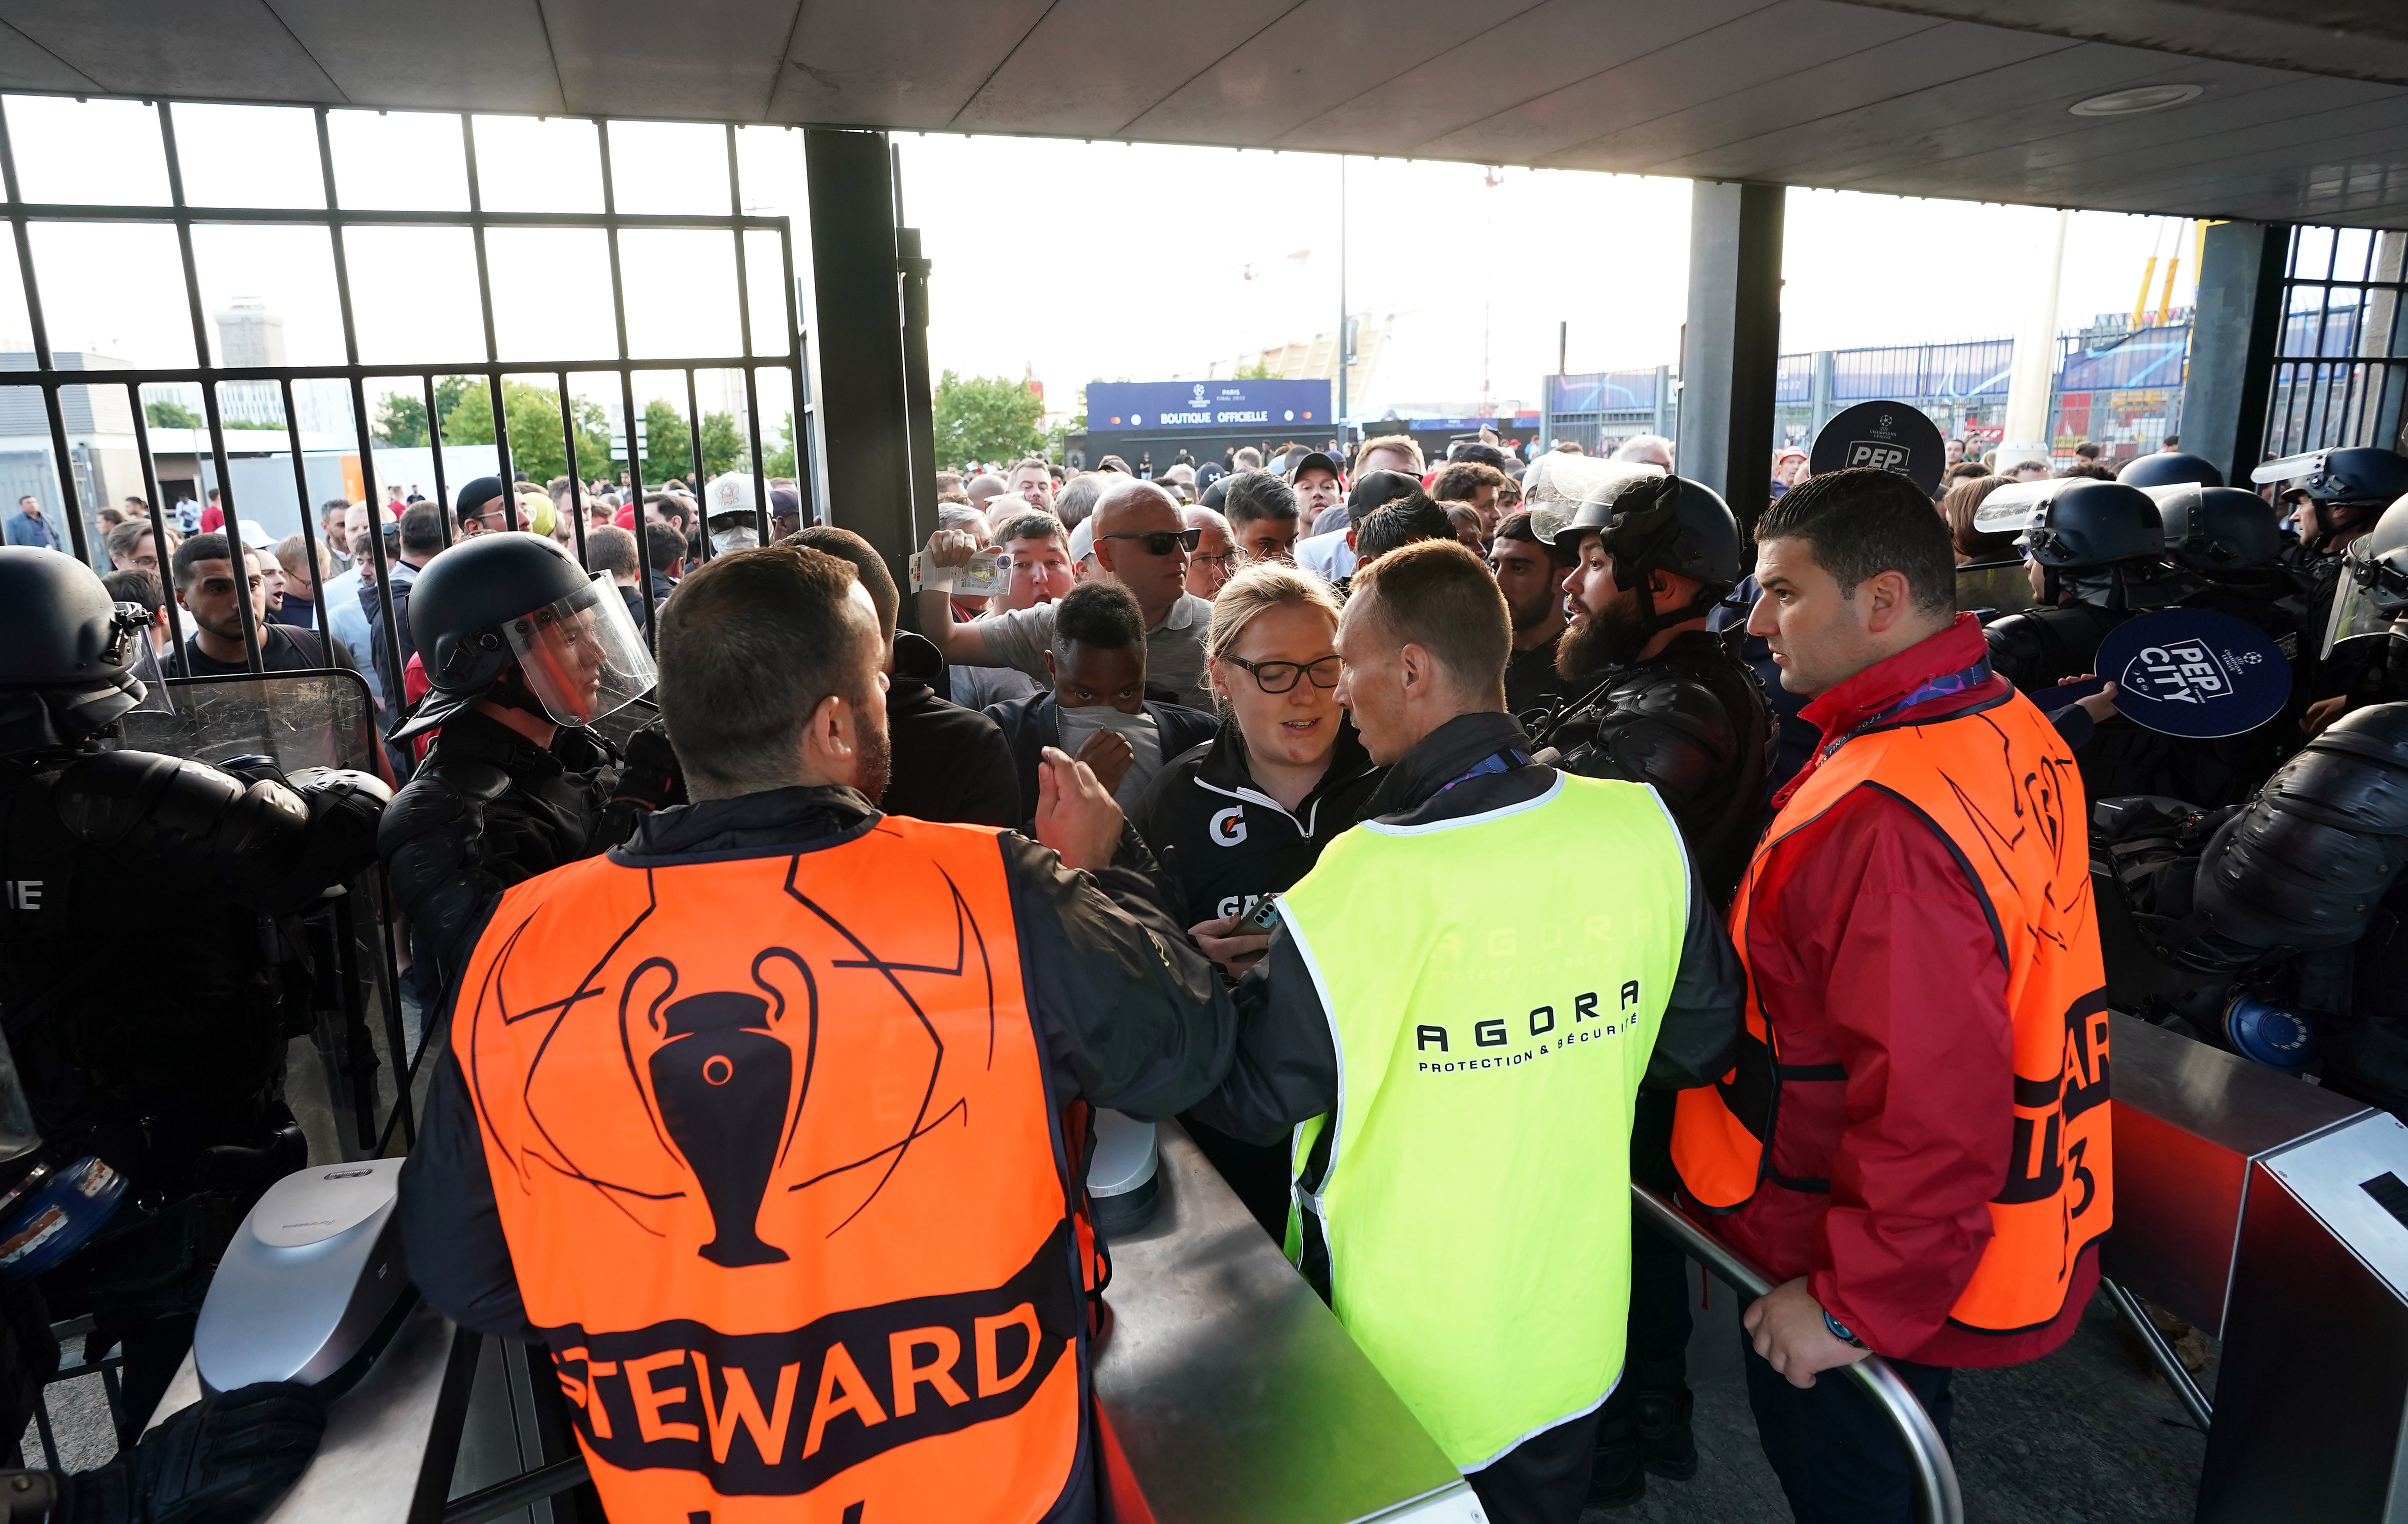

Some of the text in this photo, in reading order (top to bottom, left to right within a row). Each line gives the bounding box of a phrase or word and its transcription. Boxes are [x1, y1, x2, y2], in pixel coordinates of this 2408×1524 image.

[1160, 410, 1268, 425] BOUTIQUE OFFICIELLE
[1852, 446, 1902, 469] PEP
[718, 497, 741, 506] VERSACE
[2139, 647, 2198, 704] CITY
[2170, 647, 2222, 690] PEP
[2221, 654, 2235, 672] LEAGUE
[2223, 649, 2244, 675] CHAMPIONS
[1209, 804, 1247, 847] G
[1417, 980, 1639, 1052] AGORA
[1419, 1012, 1638, 1073] PROTECTION & SÉCURITÉ
[551, 1302, 1042, 1465] STEWARD
